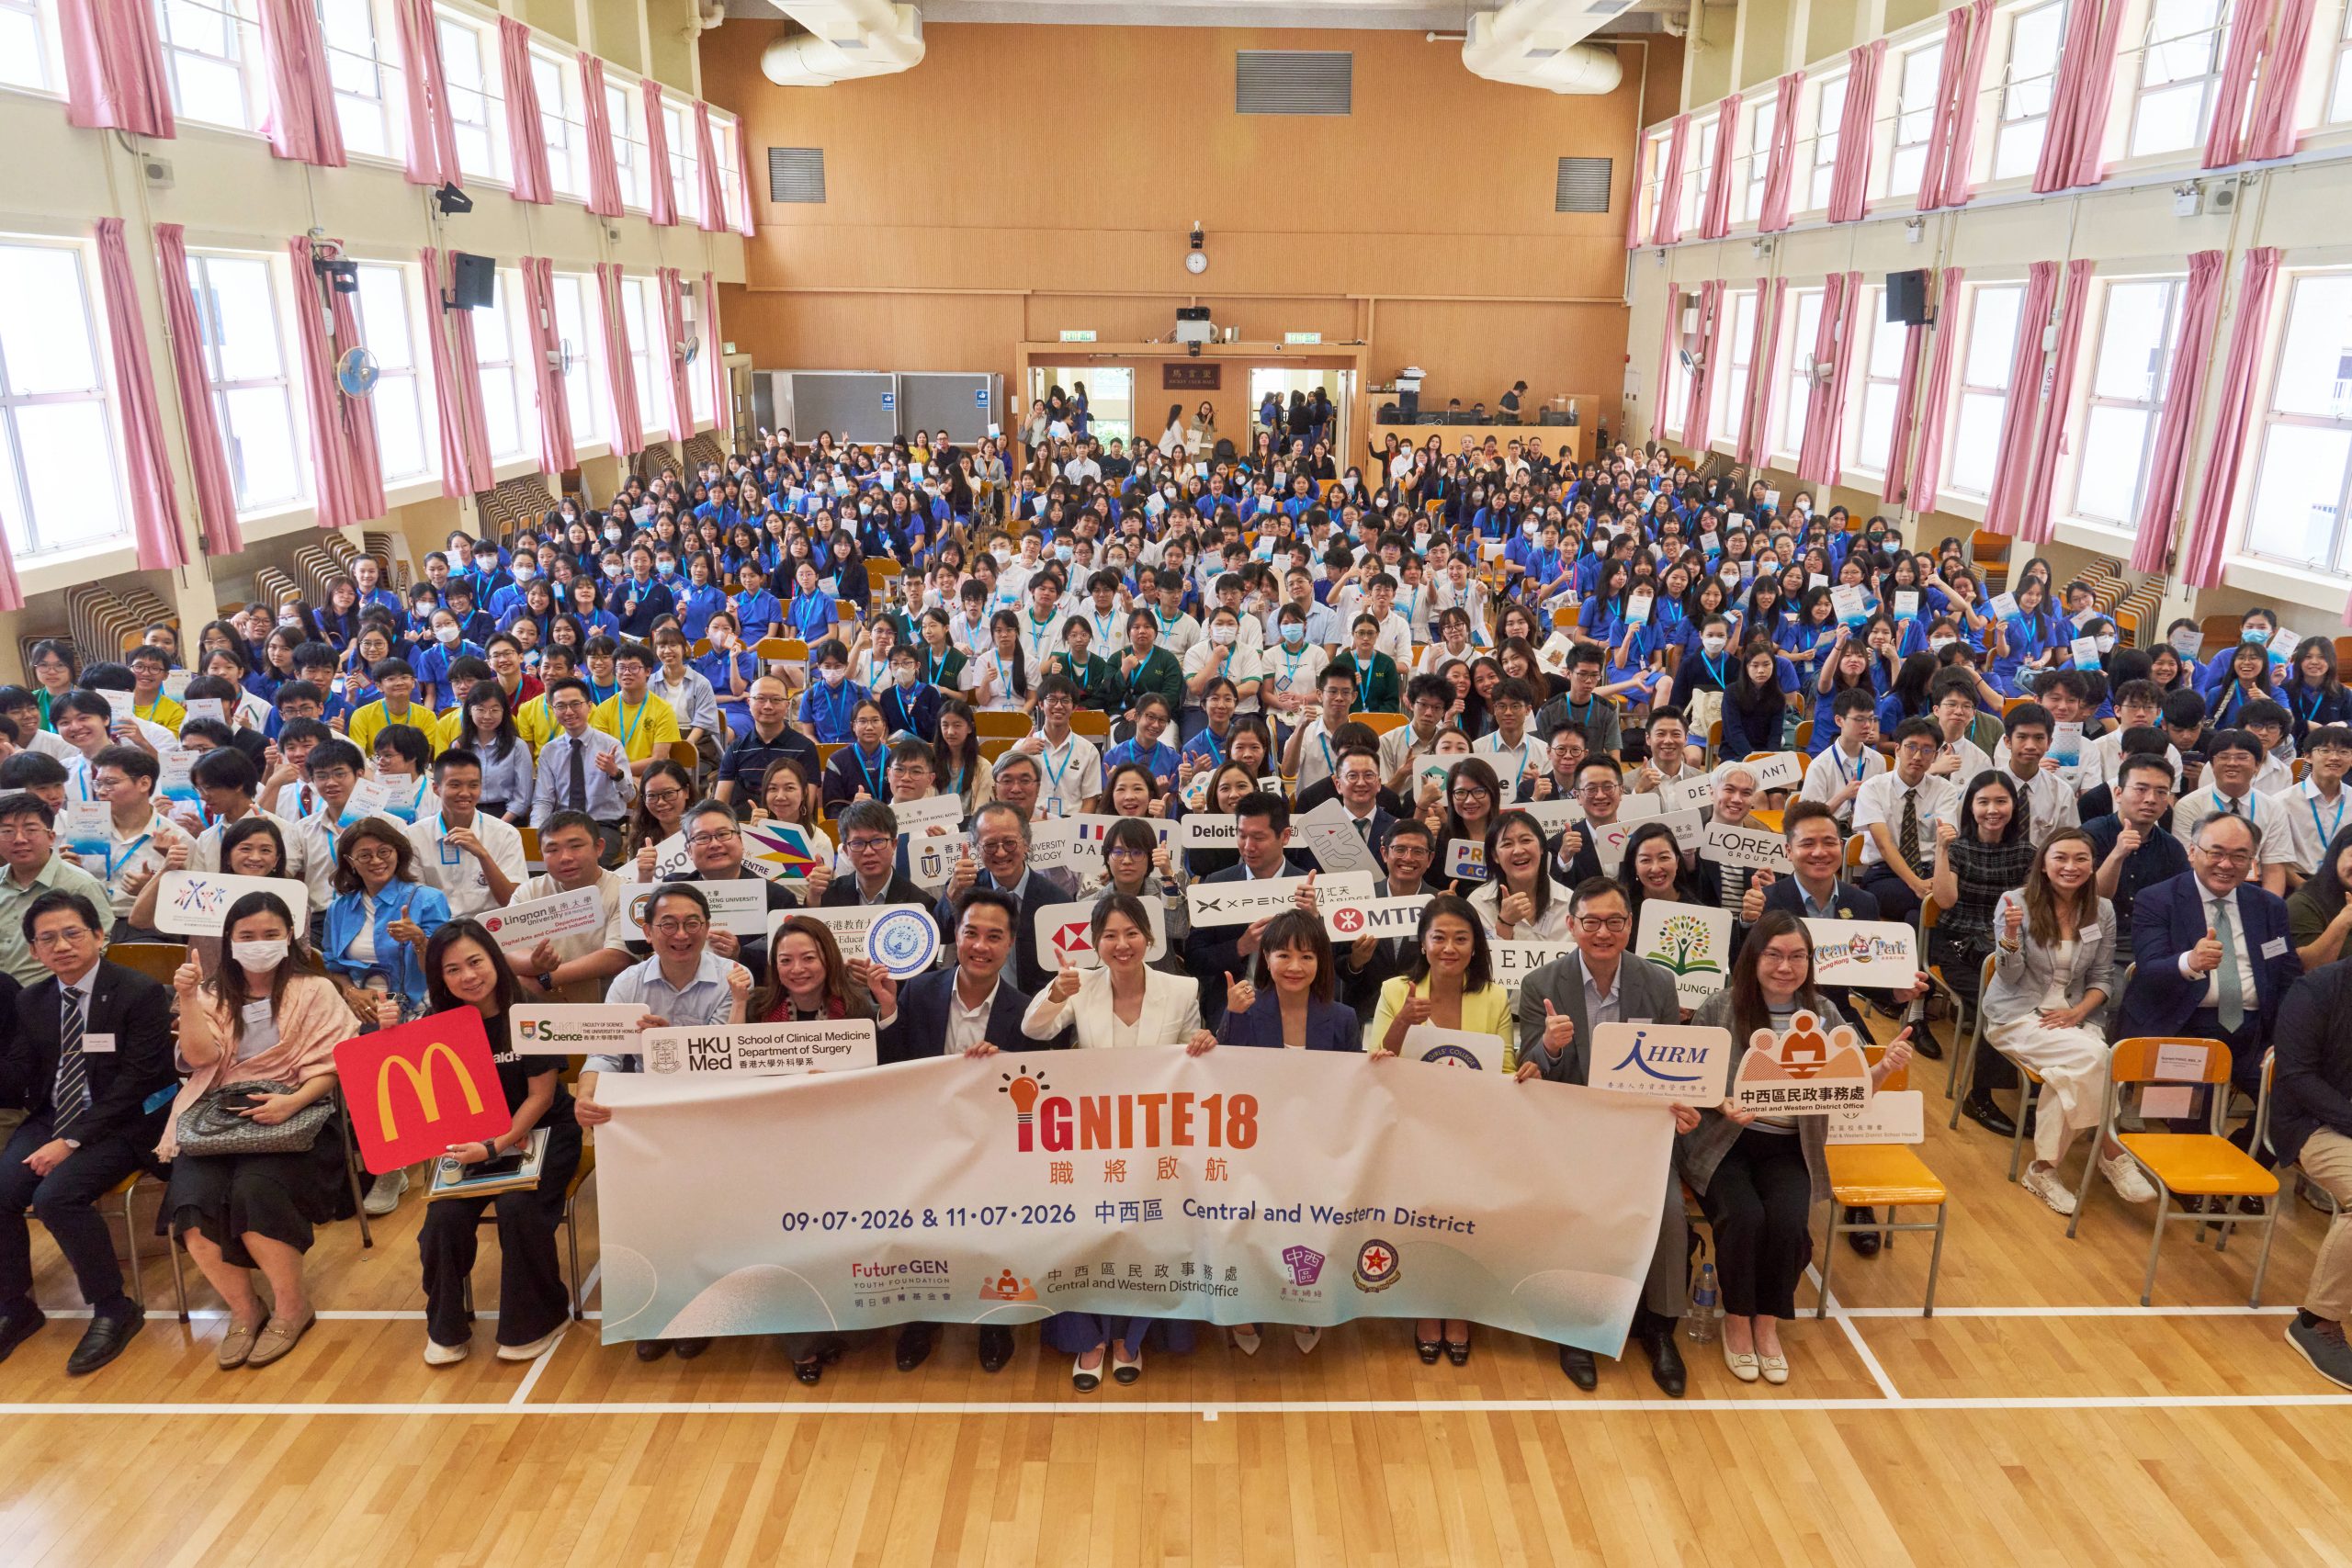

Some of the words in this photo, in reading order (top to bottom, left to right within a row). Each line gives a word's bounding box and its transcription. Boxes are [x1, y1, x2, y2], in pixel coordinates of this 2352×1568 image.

[1727, 851, 1776, 864] GROUPE
[503, 906, 547, 926] Lingnan
[527, 912, 564, 927] University
[554, 915, 587, 927] Department
[1367, 906, 1425, 927] MTR
[501, 937, 520, 947] Digital
[521, 933, 533, 942] Arts
[534, 931, 545, 939] and
[545, 925, 568, 935] Creative
[839, 935, 865, 943] Educat
[839, 946, 854, 955] ong
[1814, 942, 1849, 964] cean
[1875, 940, 1907, 955] Park
[1818, 960, 1834, 974] Hong
[1834, 957, 1849, 966] Kong
[687, 1036, 730, 1055] HKU
[738, 1034, 772, 1045] School
[774, 1033, 785, 1043] of
[786, 1032, 822, 1043] Clinical
[825, 1030, 871, 1042] Medicine
[739, 1045, 797, 1060] Department
[799, 1045, 813, 1055] of
[814, 1044, 852, 1058] Surgery
[1449, 1048, 1476, 1066] COLLEGE
[689, 1054, 732, 1071] Med
[739, 1057, 814, 1069] 香港大學外科學系
[1740, 1086, 1865, 1104] 中西區民政事務處
[1049, 1156, 1228, 1185] 職將啟航
[922, 1208, 938, 1227] &
[1094, 1199, 1164, 1224] 中西區
[1182, 1198, 1256, 1221] Central
[1263, 1203, 1302, 1224] and
[1309, 1205, 1385, 1225] Western
[1394, 1206, 1476, 1235] District
[852, 1259, 949, 1278] FutureGEN
[1047, 1261, 1238, 1282] 中西區民政事務處
[888, 1278, 950, 1286] FOUNDATION
[1046, 1278, 1090, 1293] Central
[1091, 1278, 1115, 1290] and
[1117, 1279, 1167, 1292] Western
[1170, 1280, 1207, 1292] District
[1207, 1283, 1238, 1296] Office
